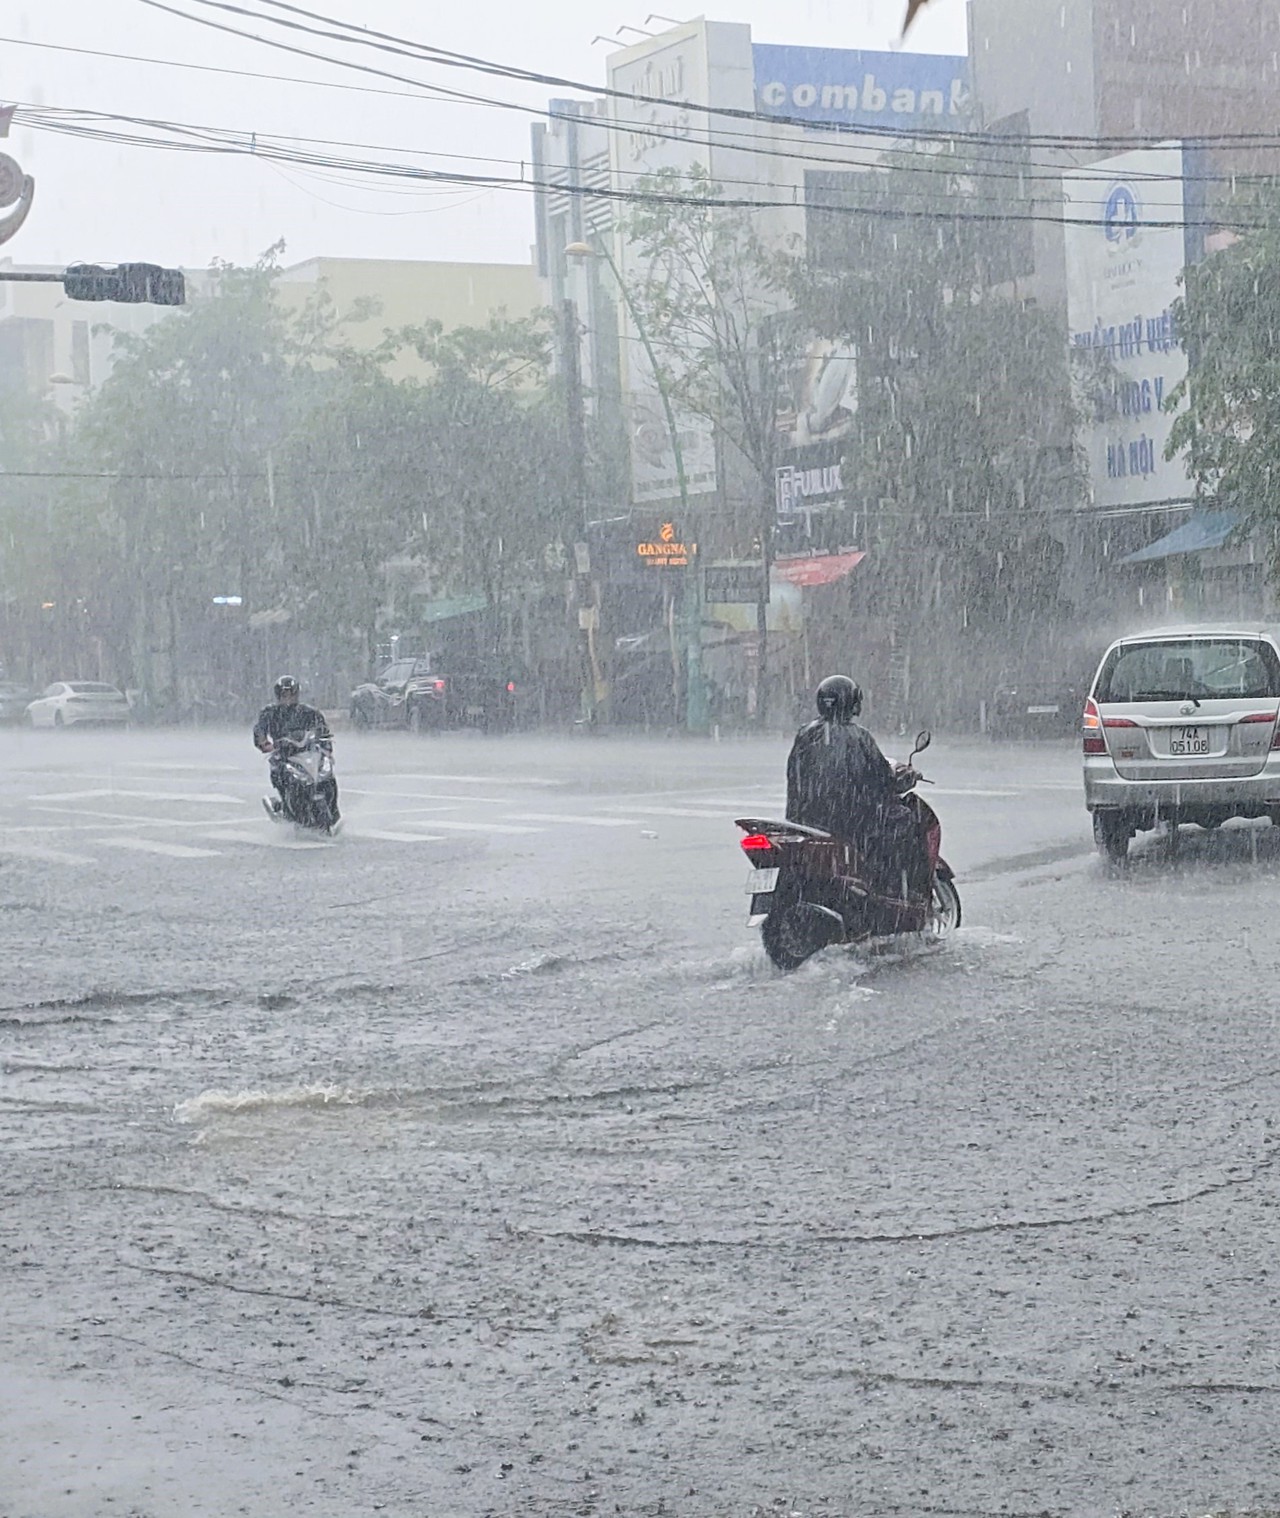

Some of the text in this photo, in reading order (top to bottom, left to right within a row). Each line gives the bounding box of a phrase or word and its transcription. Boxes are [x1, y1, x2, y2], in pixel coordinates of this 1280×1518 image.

[761, 73, 970, 116] combank
[1129, 432, 1156, 480] NỘI
[638, 543, 697, 555] GANGNA
[1179, 726, 1199, 739] 74A
